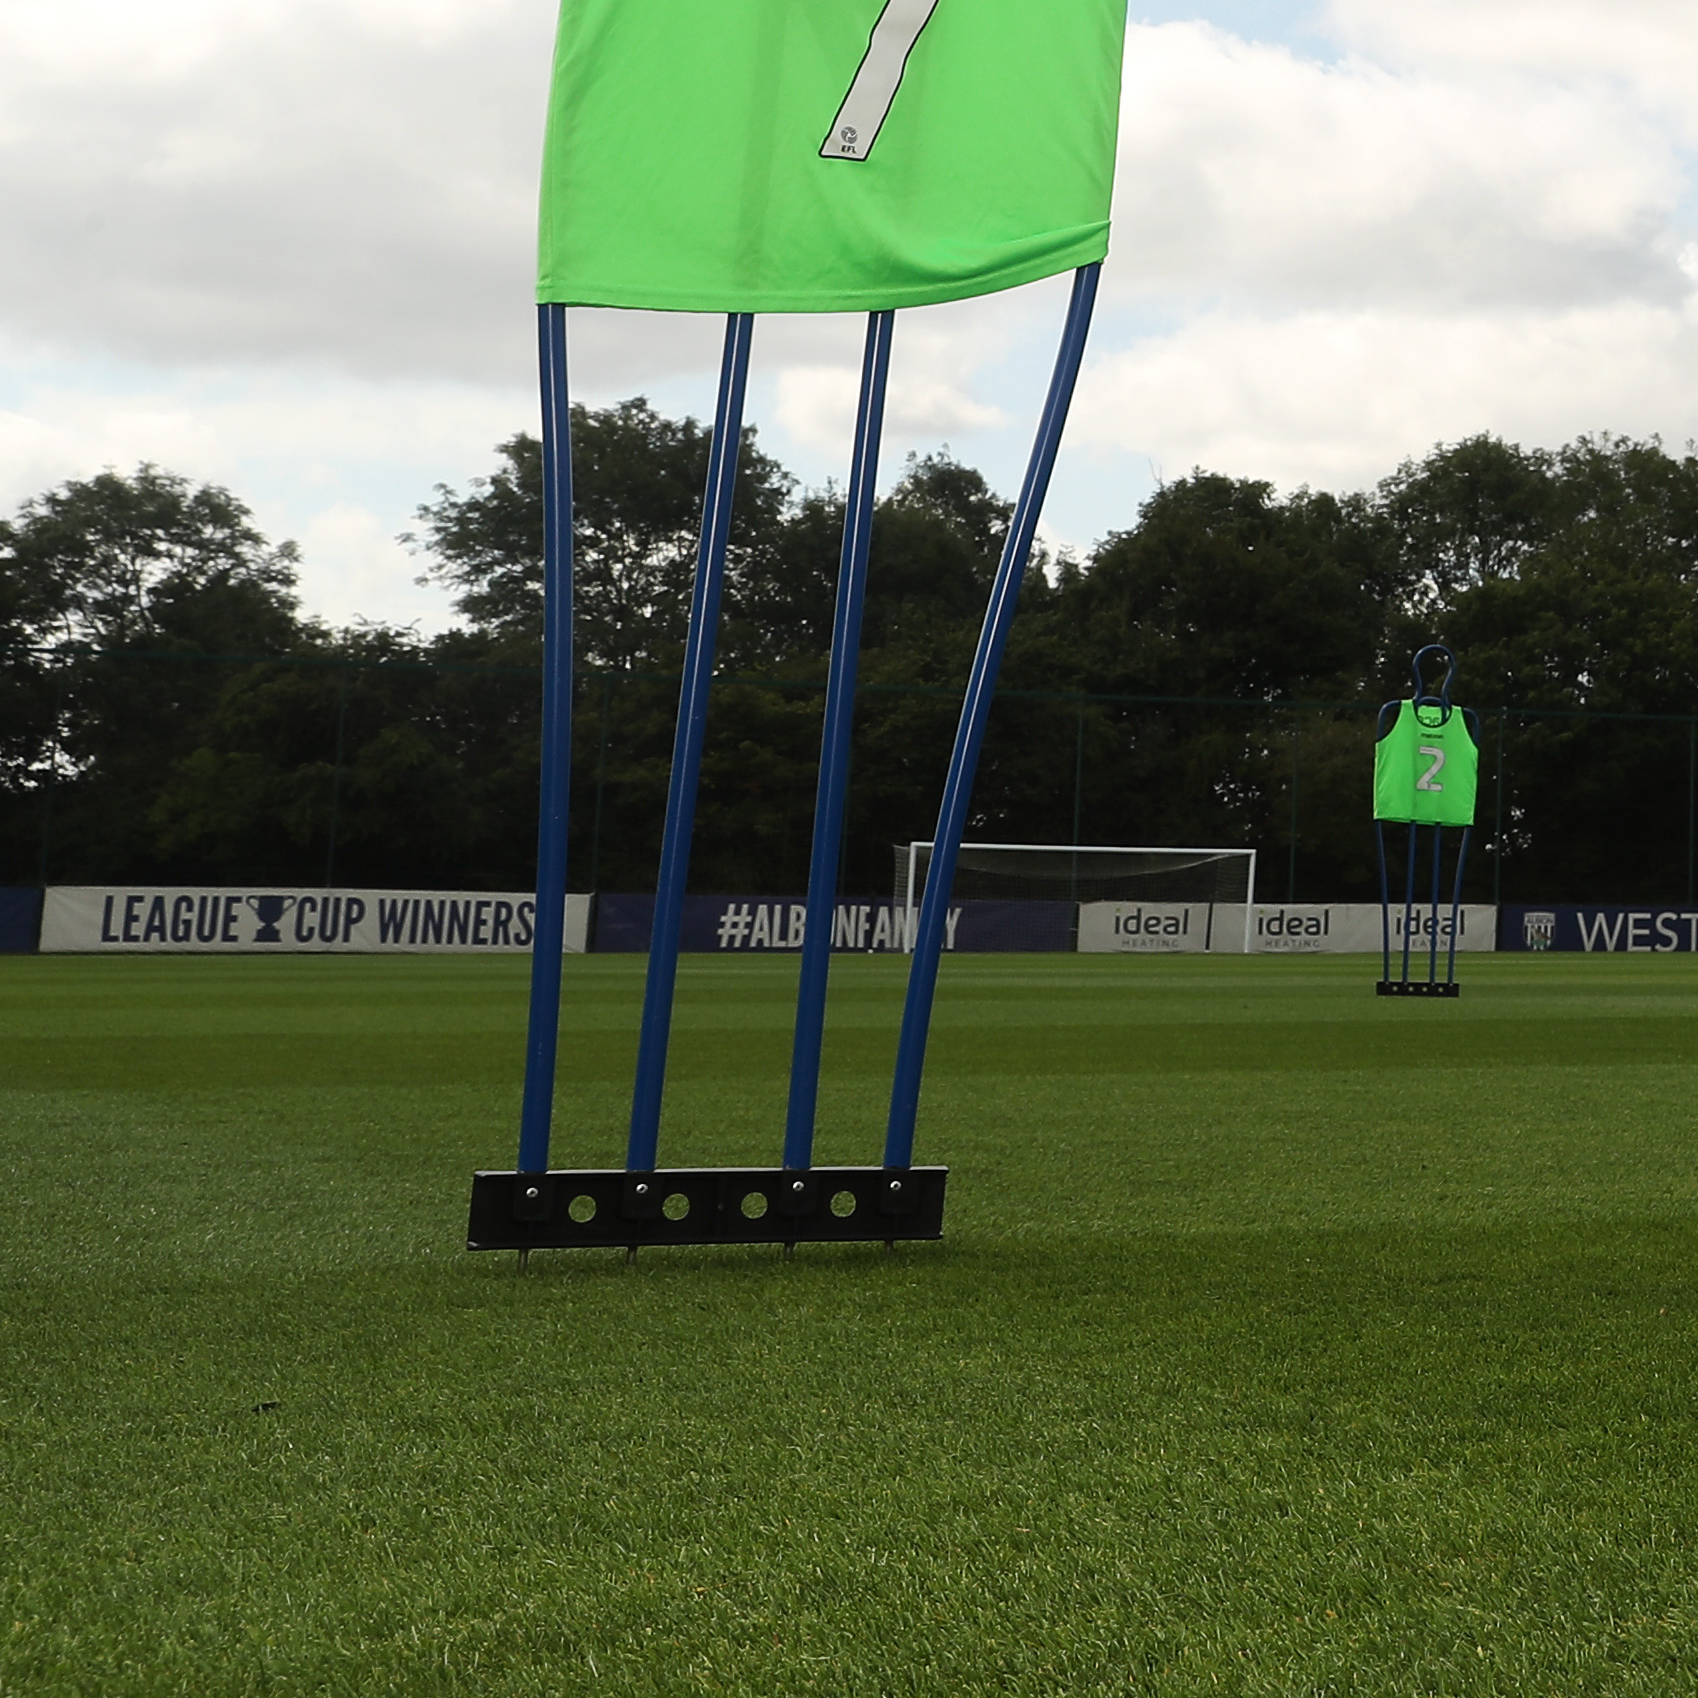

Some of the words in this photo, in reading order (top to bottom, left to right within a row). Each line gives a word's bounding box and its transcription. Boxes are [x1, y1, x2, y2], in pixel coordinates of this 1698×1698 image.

[841, 145, 857, 154] EFL
[1416, 746, 1446, 792] 2
[101, 895, 243, 943] LEAGUE
[295, 895, 366, 943] CUP
[378, 898, 536, 947] WINNERS
[1114, 908, 1190, 935] ideal
[1258, 909, 1329, 936] ideal
[1122, 939, 1180, 948] HEATING
[1265, 939, 1321, 949] HEATING
